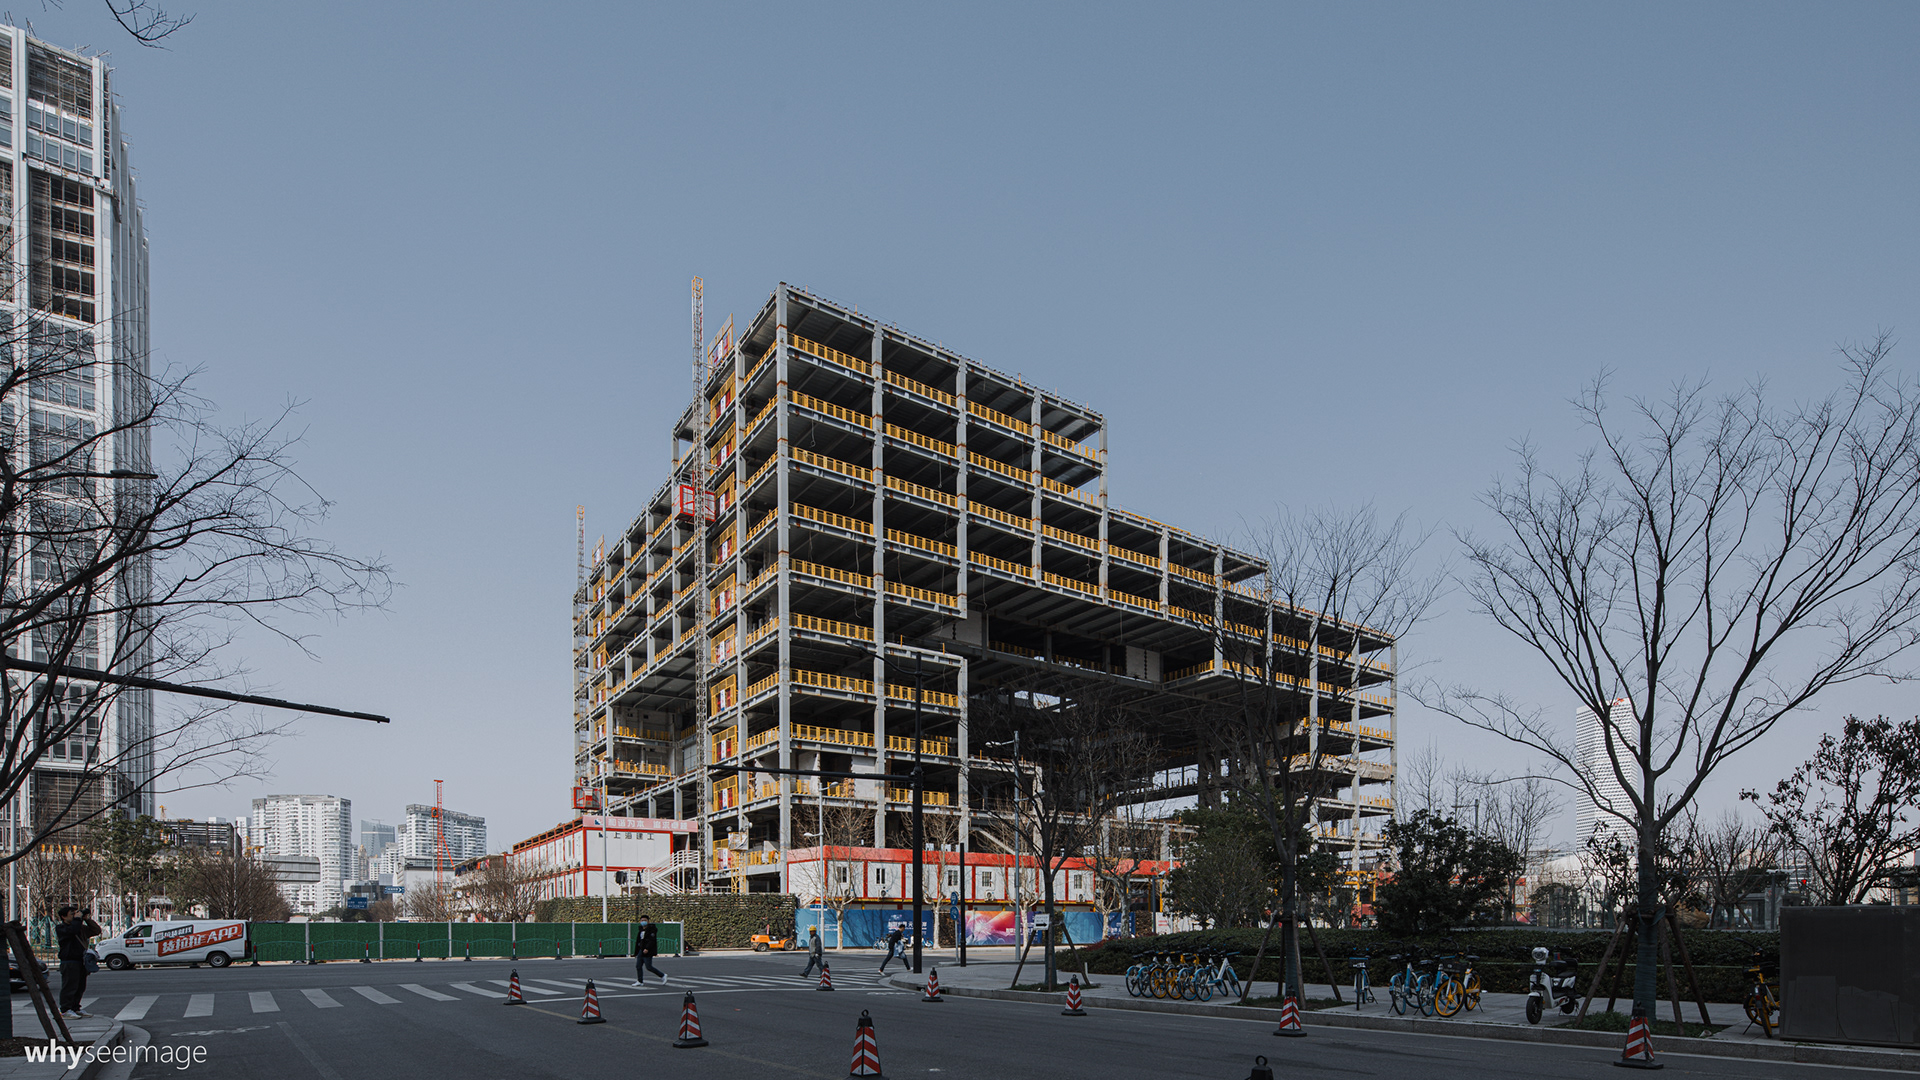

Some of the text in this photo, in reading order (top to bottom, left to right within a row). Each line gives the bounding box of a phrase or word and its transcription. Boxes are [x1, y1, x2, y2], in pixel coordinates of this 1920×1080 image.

[608, 818, 644, 828] 和谐为本
[613, 832, 654, 840] 上海建工
